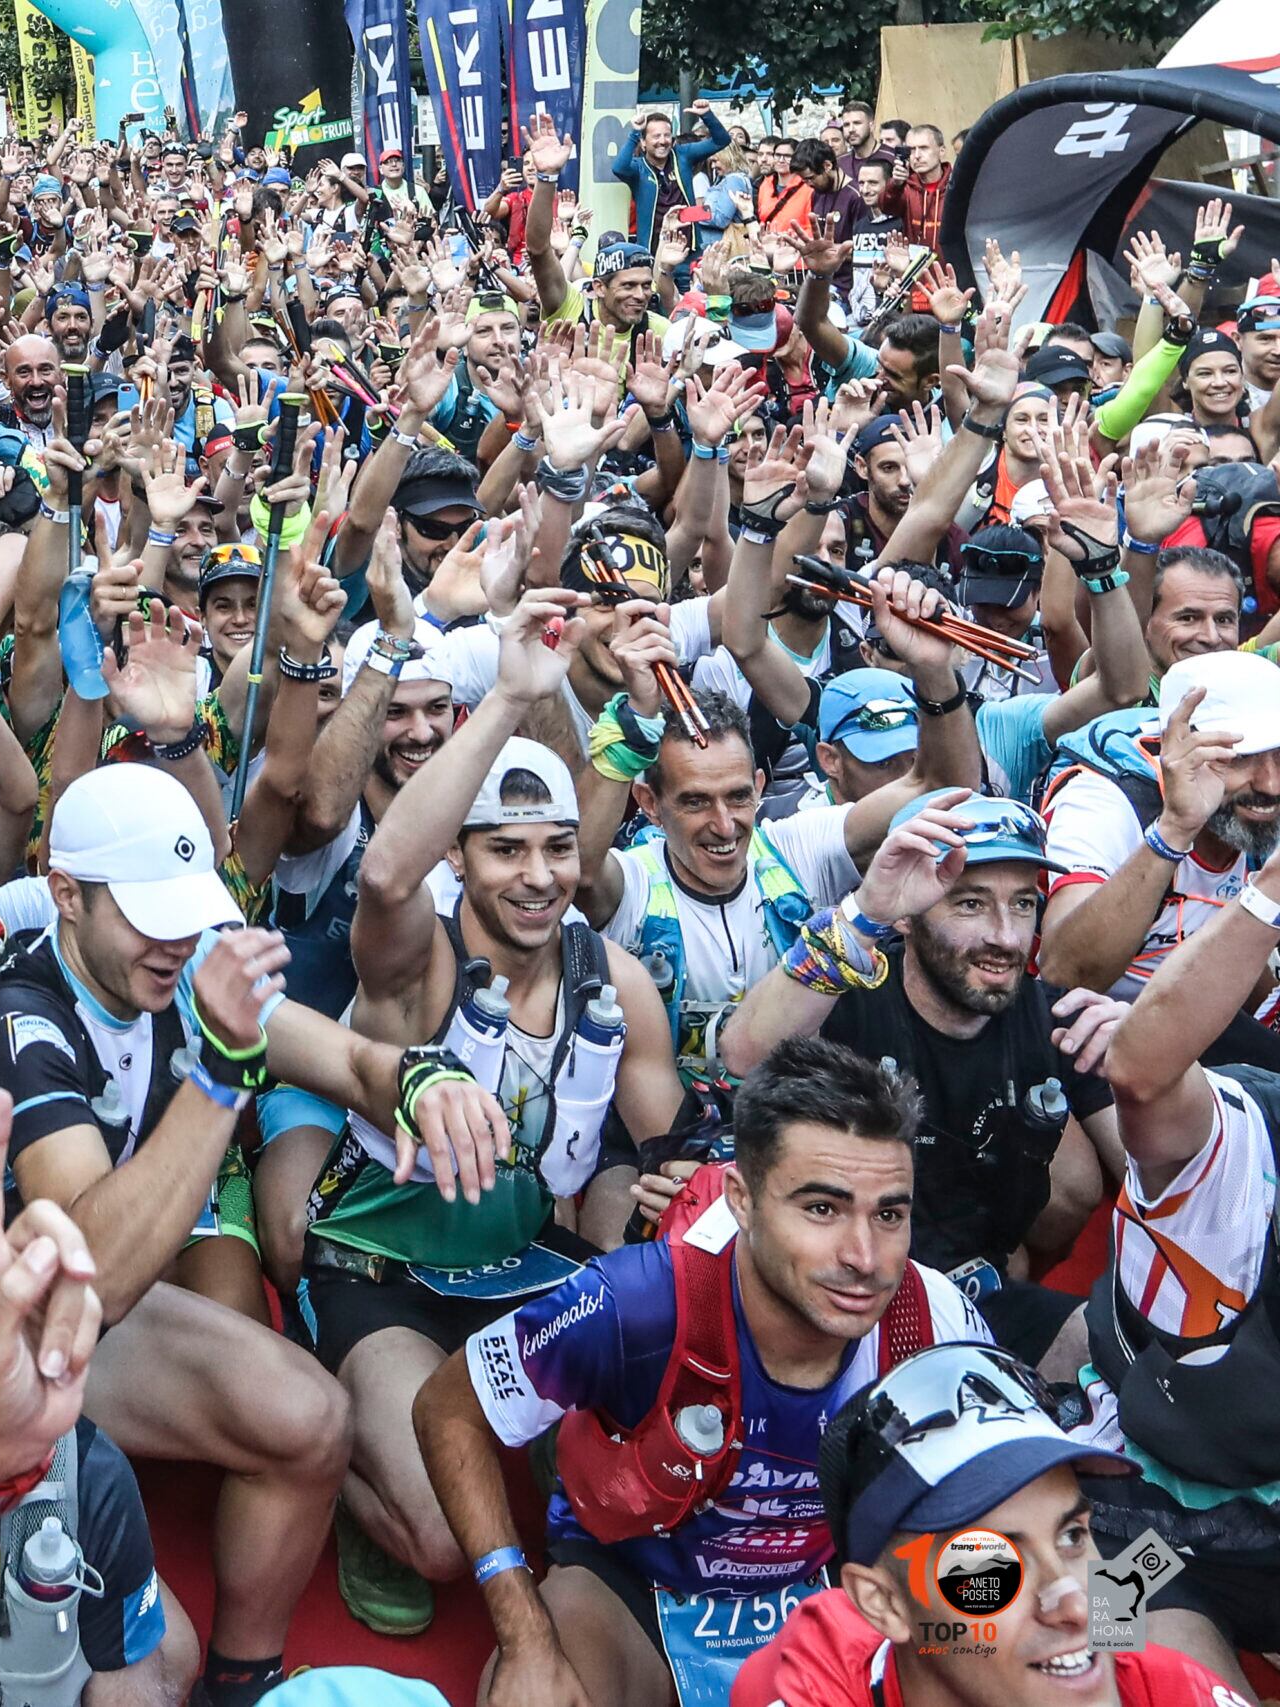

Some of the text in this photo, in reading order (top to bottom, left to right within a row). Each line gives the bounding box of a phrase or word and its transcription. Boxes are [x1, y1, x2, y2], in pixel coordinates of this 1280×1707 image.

[272, 105, 327, 133] Sport
[291, 120, 352, 146] BIOFRUTA
[523, 1285, 605, 1360] knoweats!
[489, 1336, 518, 1399] PKAL
[705, 1638, 721, 1649] PAU
[721, 1636, 754, 1648] PASCUAL
